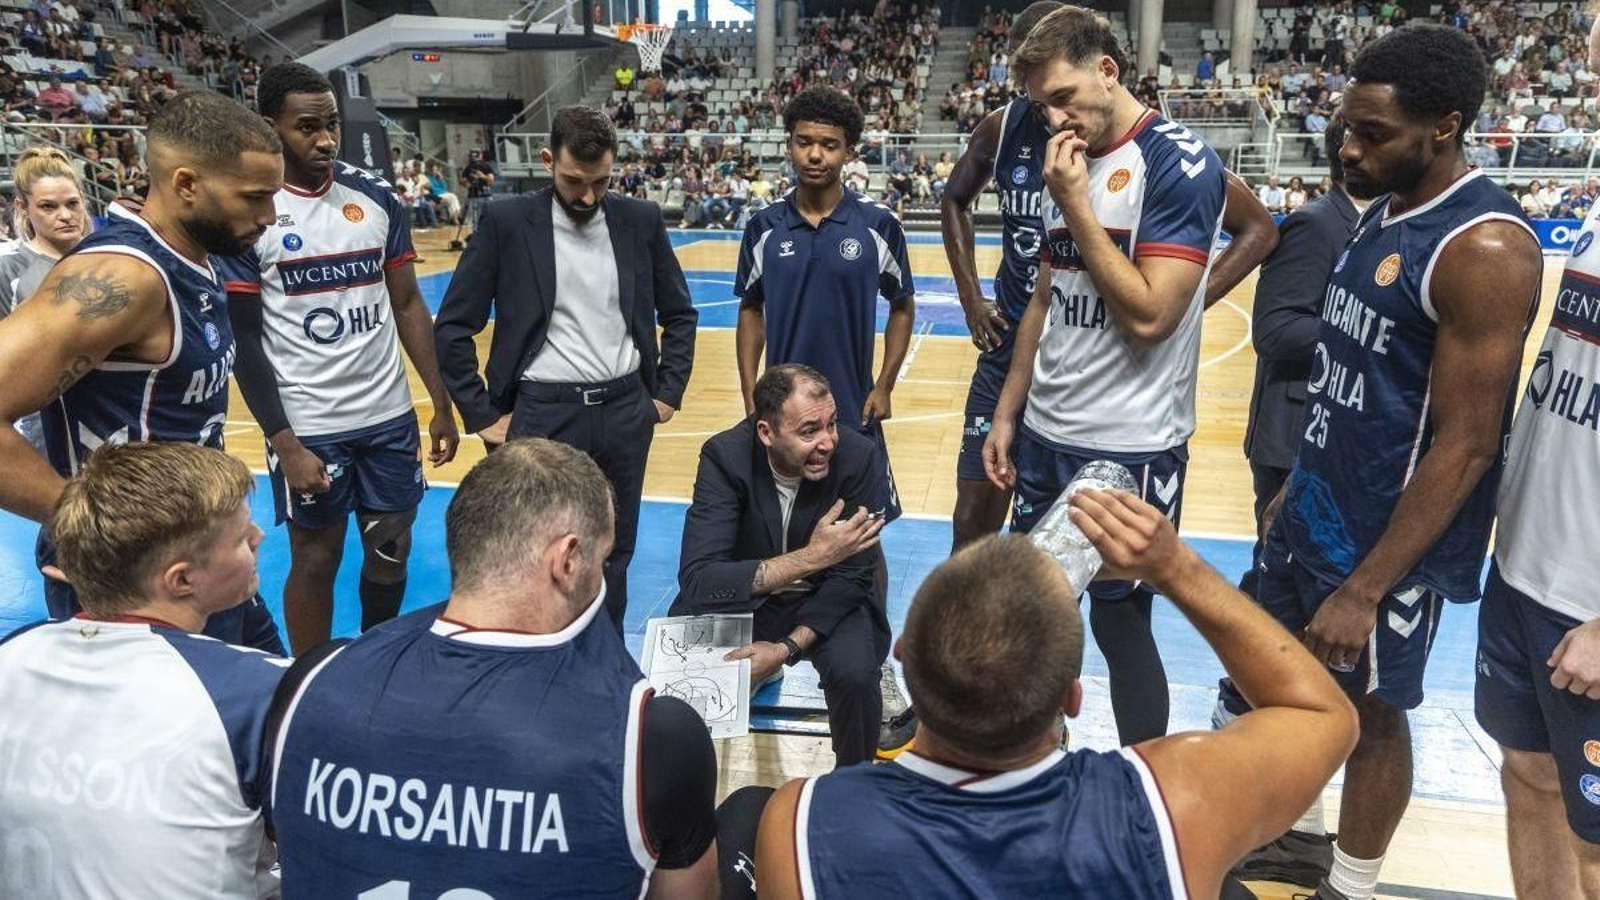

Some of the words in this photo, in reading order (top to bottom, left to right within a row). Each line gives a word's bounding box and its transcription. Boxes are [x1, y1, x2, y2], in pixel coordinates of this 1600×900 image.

[348, 303, 383, 334] HLA
[1065, 295, 1106, 329] HLA
[1327, 361, 1365, 412] HLA
[1550, 369, 1600, 430] HLA
[1305, 402, 1330, 449] 25
[0, 734, 166, 812] LSSON
[304, 758, 569, 853] KORSANTIA
